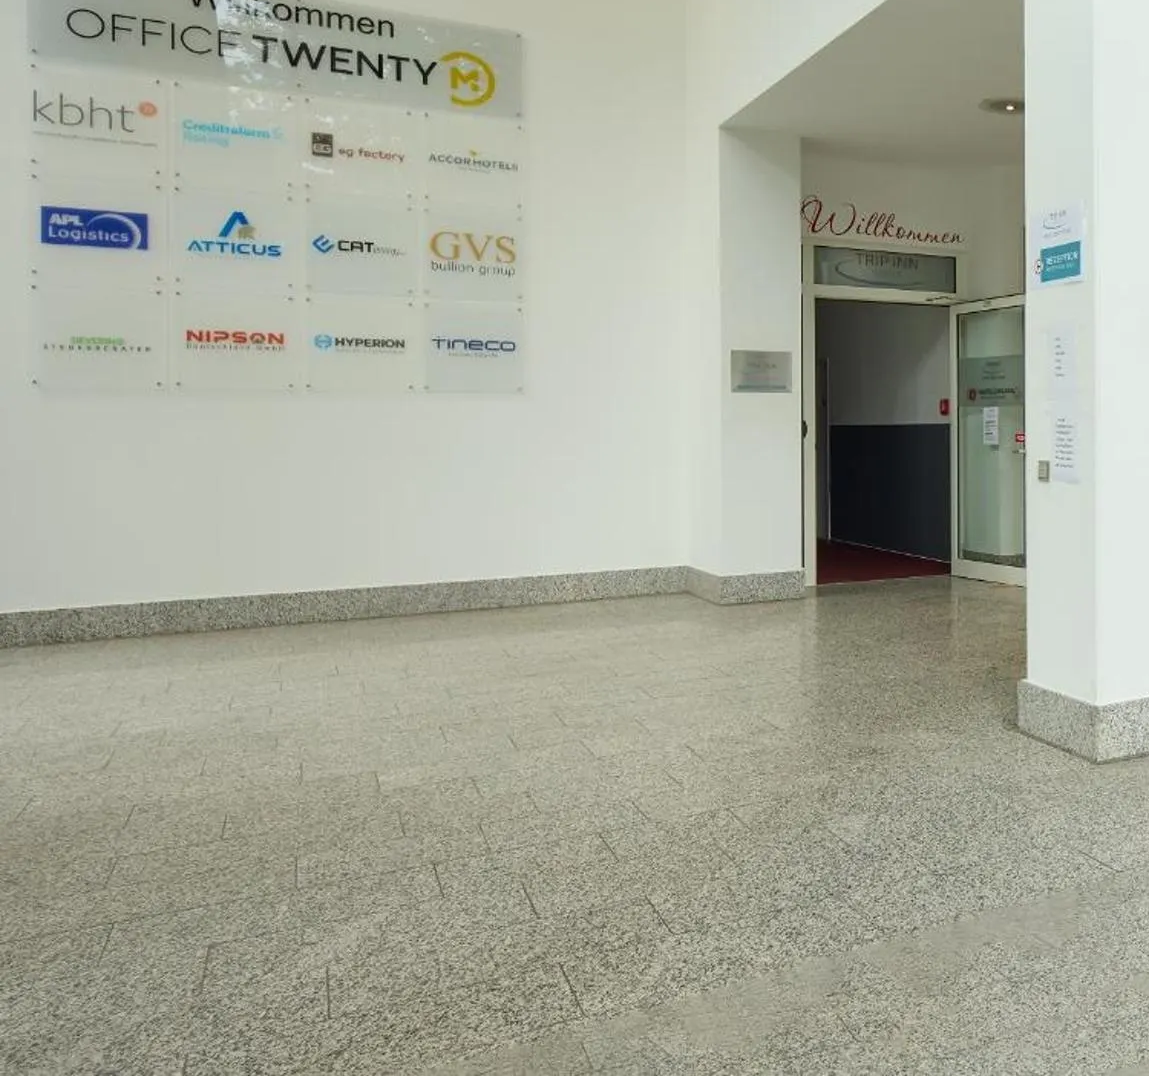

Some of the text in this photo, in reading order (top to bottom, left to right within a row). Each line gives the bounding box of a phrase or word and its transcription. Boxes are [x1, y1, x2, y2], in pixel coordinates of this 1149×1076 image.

[66, 8, 242, 58] OFFICE
[252, 35, 437, 85] TWENTY
[33, 89, 136, 133] kbht
[50, 213, 84, 227] APL
[800, 195, 964, 244] Willkommen
[48, 225, 129, 243] Logistics
[188, 240, 282, 257] ATTICUS
[337, 240, 375, 253] CAT
[429, 231, 516, 264] GVS
[431, 260, 474, 273] bullion
[186, 329, 285, 345] NIPSON
[335, 337, 405, 349] HYPERION
